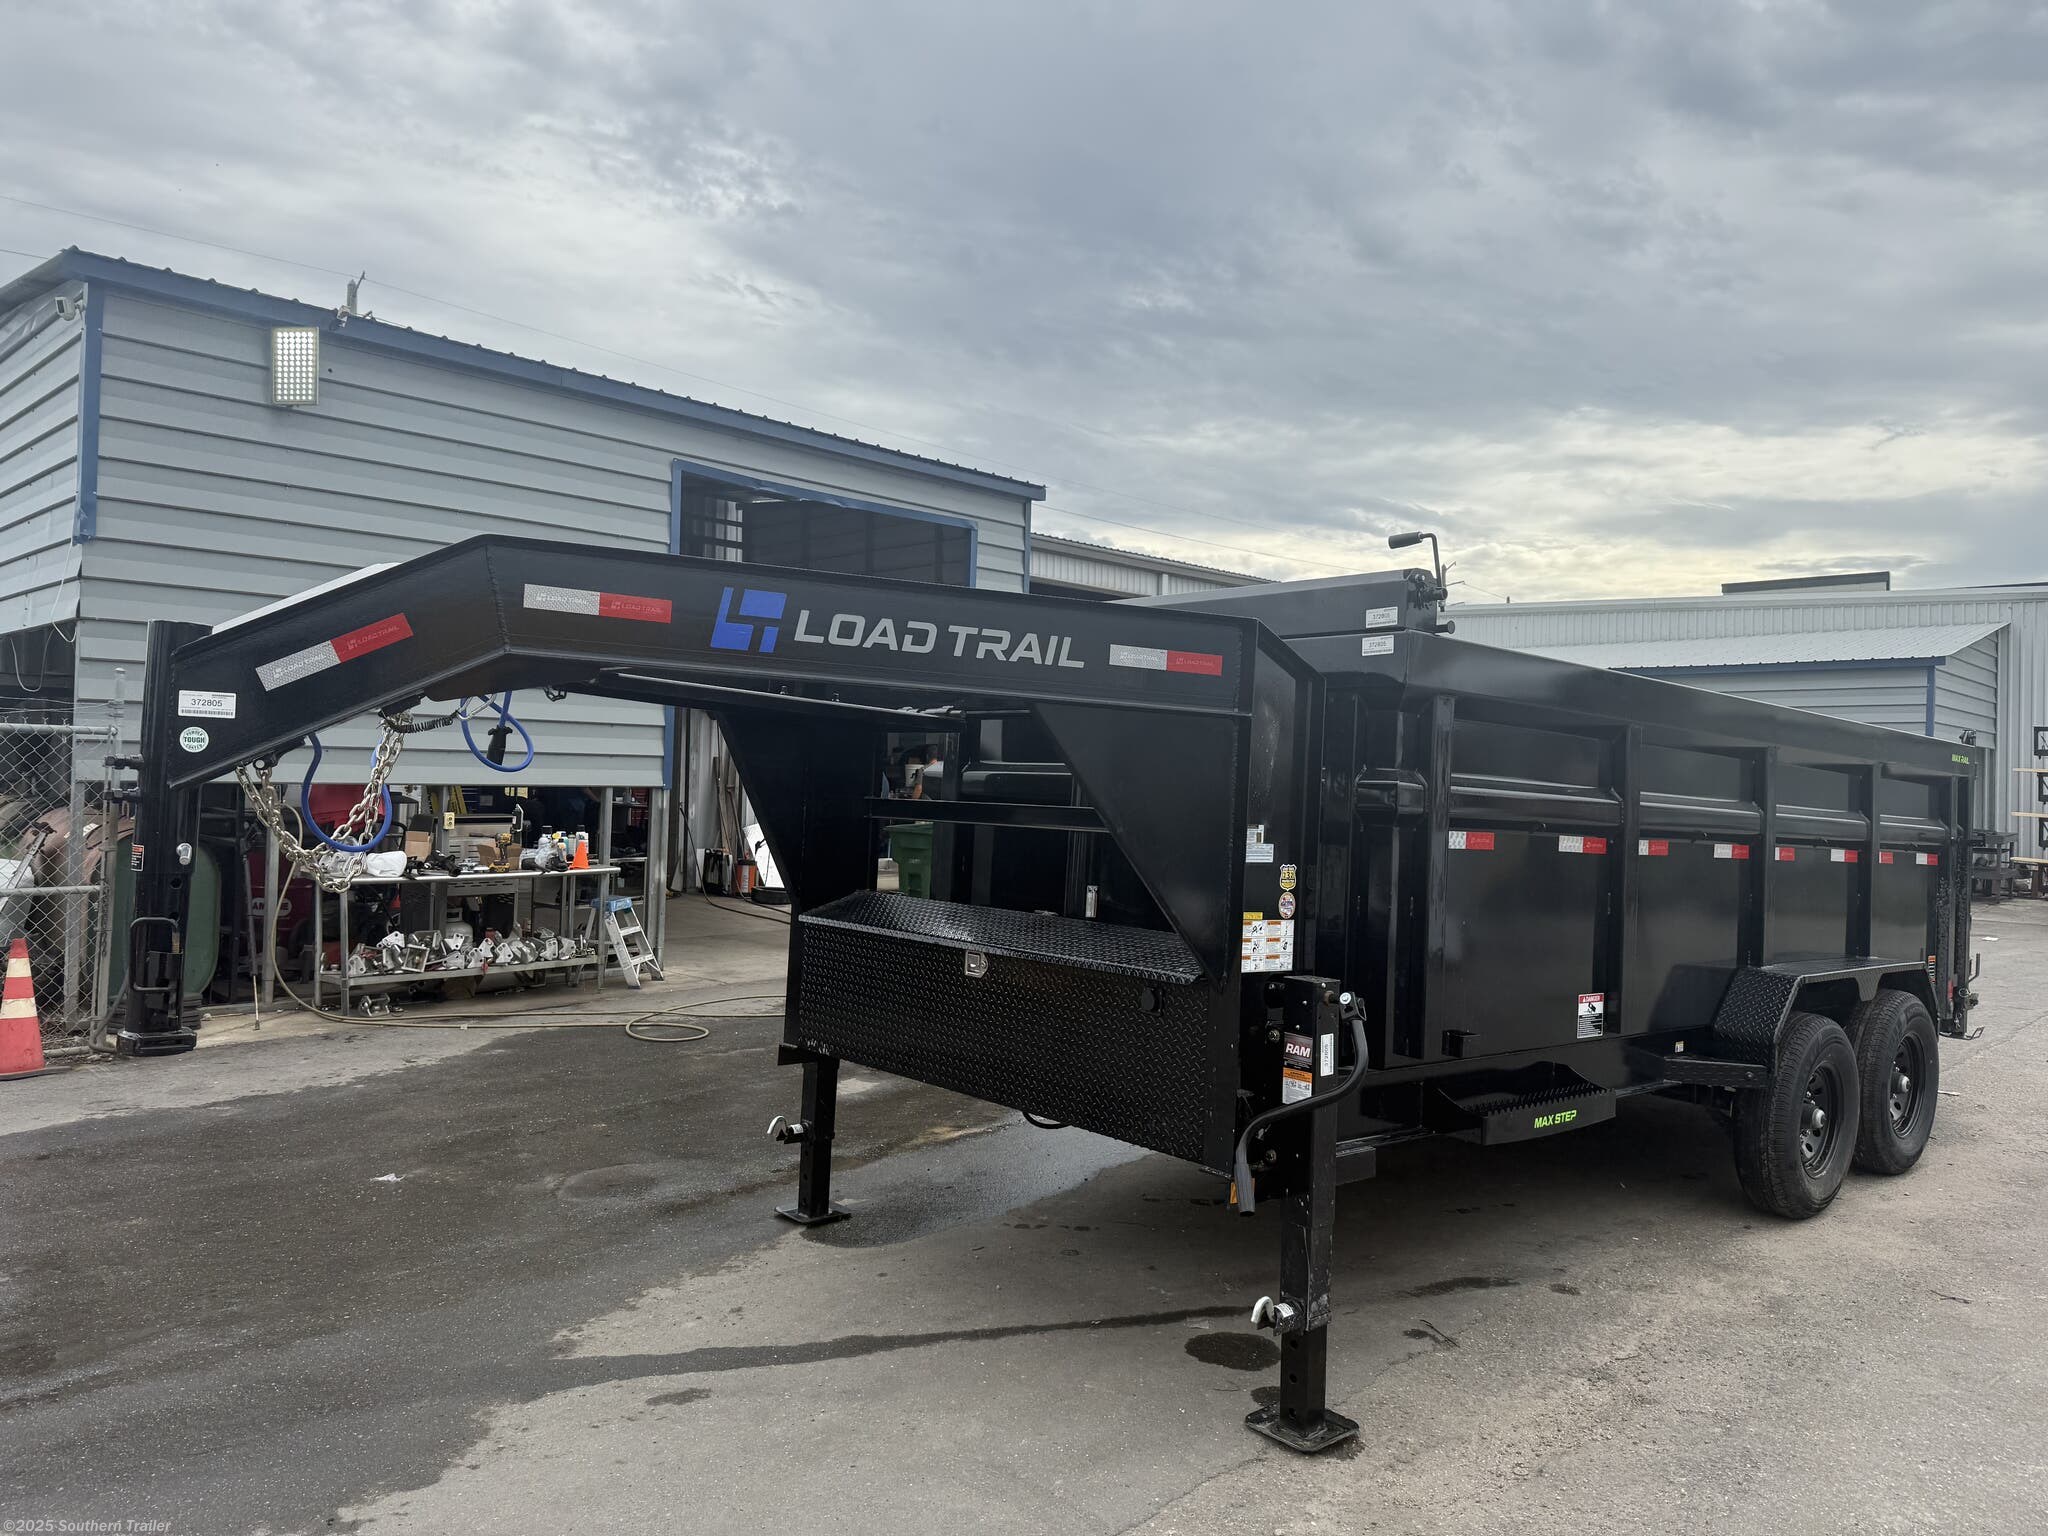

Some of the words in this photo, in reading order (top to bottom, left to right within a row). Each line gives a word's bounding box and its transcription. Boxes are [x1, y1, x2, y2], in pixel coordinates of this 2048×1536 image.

[794, 609, 937, 653] LOAD
[948, 625, 1085, 668] TRAIL
[191, 699, 223, 707] 372805
[1285, 1043, 1311, 1058] RAM
[1534, 1115, 1554, 1128] MAX
[1554, 1110, 1577, 1124] STEP
